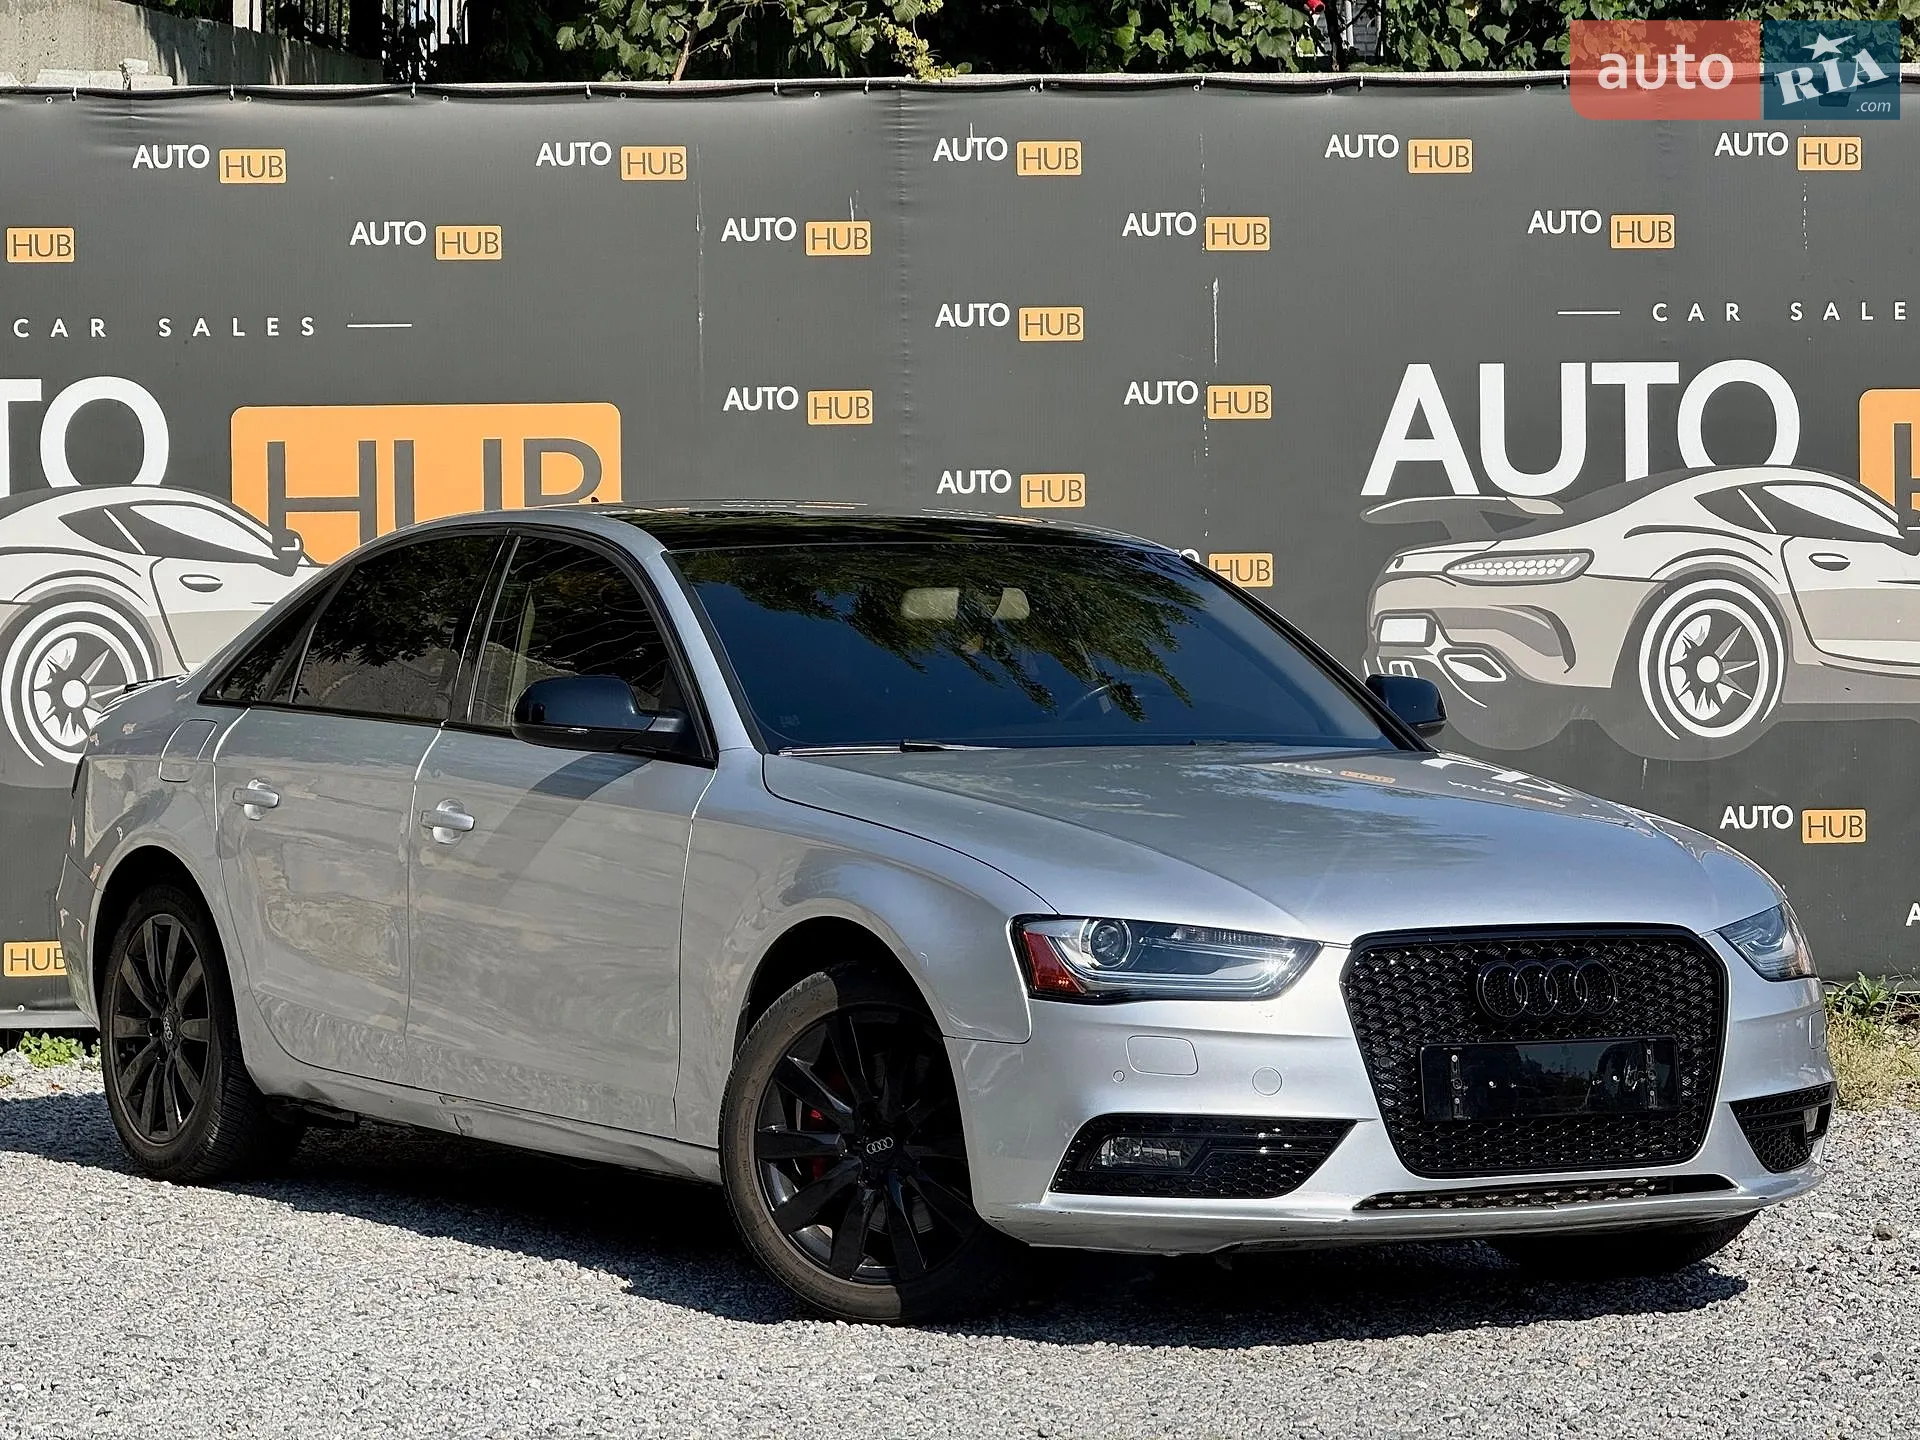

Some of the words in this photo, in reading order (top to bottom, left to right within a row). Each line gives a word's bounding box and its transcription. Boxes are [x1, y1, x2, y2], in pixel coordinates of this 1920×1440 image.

[133, 145, 209, 169] AUTO
[225, 155, 284, 179] HUB
[536, 141, 612, 166] AUTO
[626, 152, 684, 176] HUB
[933, 136, 1008, 161] AUTO
[1022, 147, 1079, 171] HUB
[1325, 134, 1400, 158] AUTO
[1414, 145, 1470, 168] HUB
[1715, 132, 1789, 156] AUTO
[1803, 142, 1859, 166] HUB
[350, 221, 427, 246] AUTO
[441, 231, 499, 255] HUB
[721, 217, 796, 242] AUTO
[811, 227, 869, 251] HUB
[1122, 212, 1197, 236] AUTO
[1211, 222, 1268, 246] HUB
[1527, 209, 1602, 234] AUTO
[1616, 220, 1673, 244] HUB
[12, 233, 72, 258] HUB
[13, 318, 106, 338] CAR
[158, 317, 315, 337] SALES
[935, 303, 1010, 328] AUTO
[1024, 312, 1081, 337] HUB
[1652, 302, 1741, 322] CAR
[1790, 301, 1907, 321] SALE
[723, 386, 799, 411] AUTO
[813, 396, 870, 420] HUB
[1124, 381, 1199, 406] AUTO
[1213, 391, 1269, 414] HUB
[1361, 360, 1800, 496] AUTO
[937, 470, 1012, 494] AUTO
[1026, 479, 1083, 503] HUB
[1214, 559, 1271, 582] HUB
[1720, 805, 1794, 830] AUTO
[1807, 815, 1863, 839] HUB
